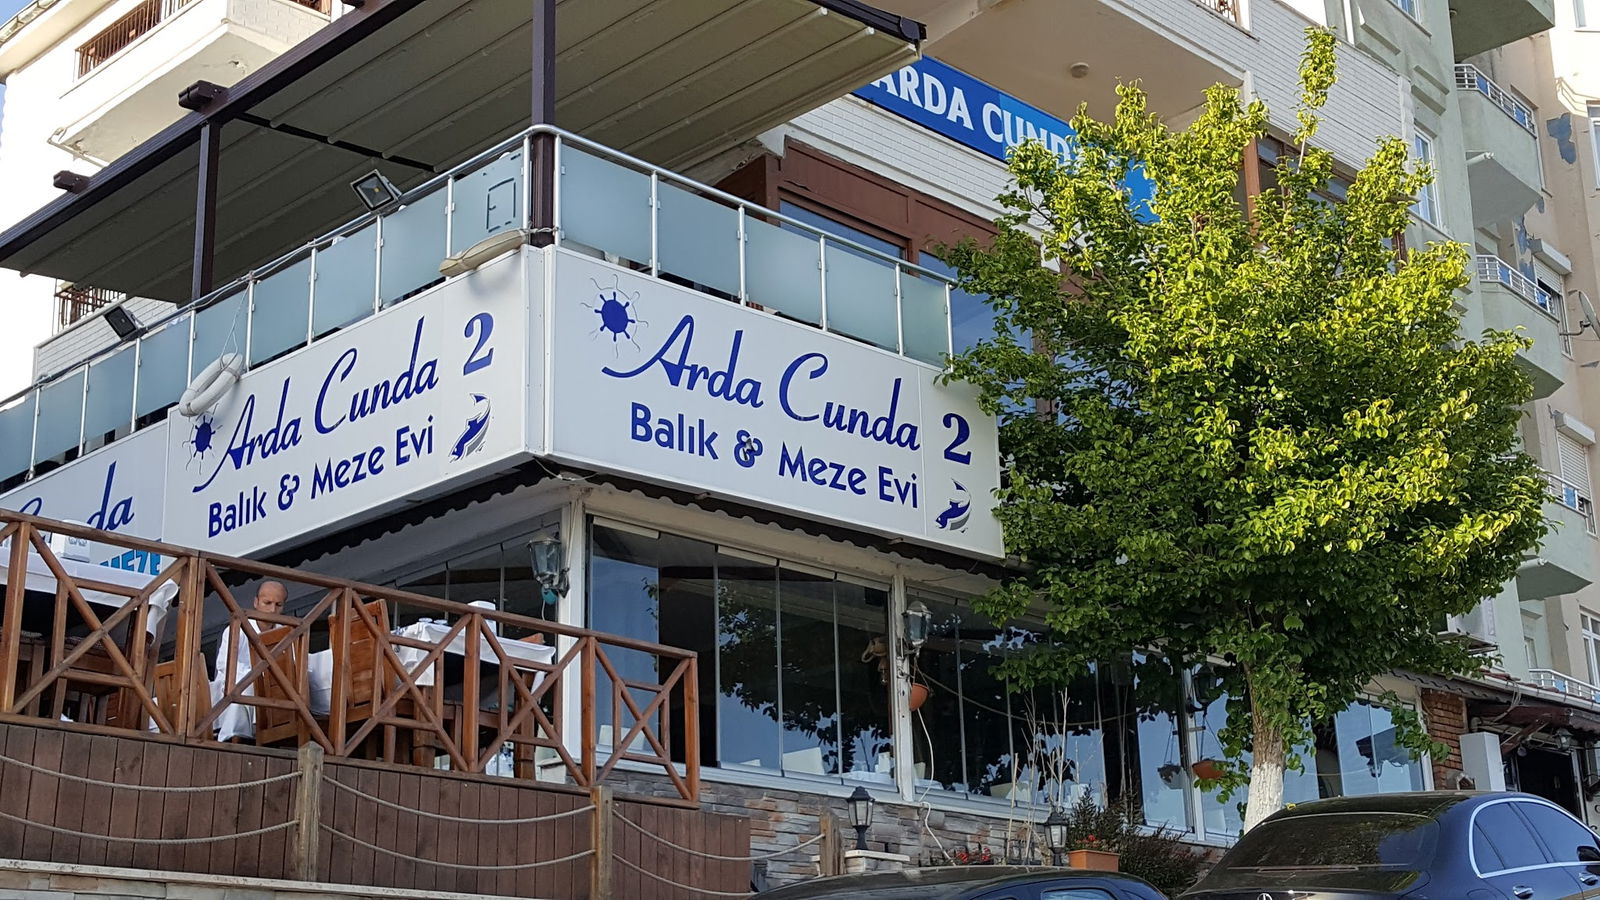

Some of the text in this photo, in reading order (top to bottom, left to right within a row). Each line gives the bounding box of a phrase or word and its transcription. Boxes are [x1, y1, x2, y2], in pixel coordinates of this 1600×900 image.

[870, 66, 1083, 168] ARDA CUND
[192, 311, 495, 494] Arda Cunda 2
[602, 314, 972, 466] Arda Cunda 2
[207, 414, 434, 539] Balık & Meze Evi
[630, 401, 919, 510] Balık & Meze Evi
